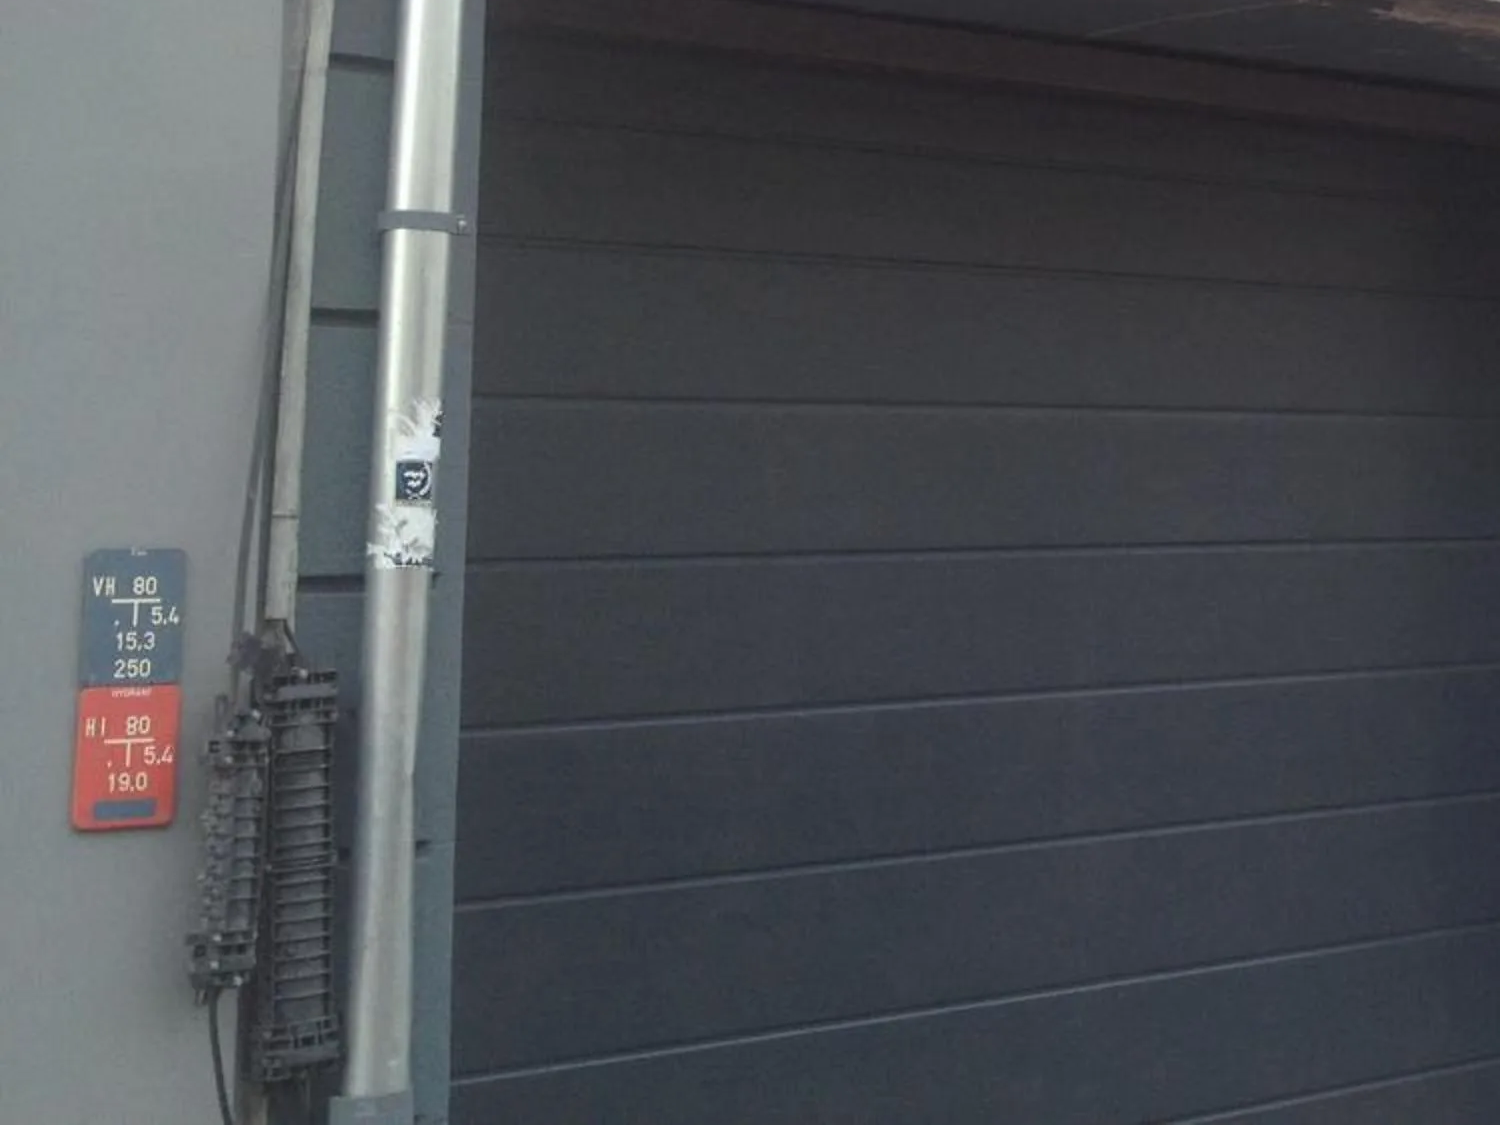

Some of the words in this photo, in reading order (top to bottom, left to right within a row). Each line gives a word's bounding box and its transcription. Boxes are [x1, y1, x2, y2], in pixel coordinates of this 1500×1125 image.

[92, 575, 116, 597] VH
[132, 575, 158, 596] 80
[113, 657, 152, 678] 250
[126, 715, 151, 735] 80
[142, 744, 175, 765] 5.4
[107, 771, 148, 793] 19.0
